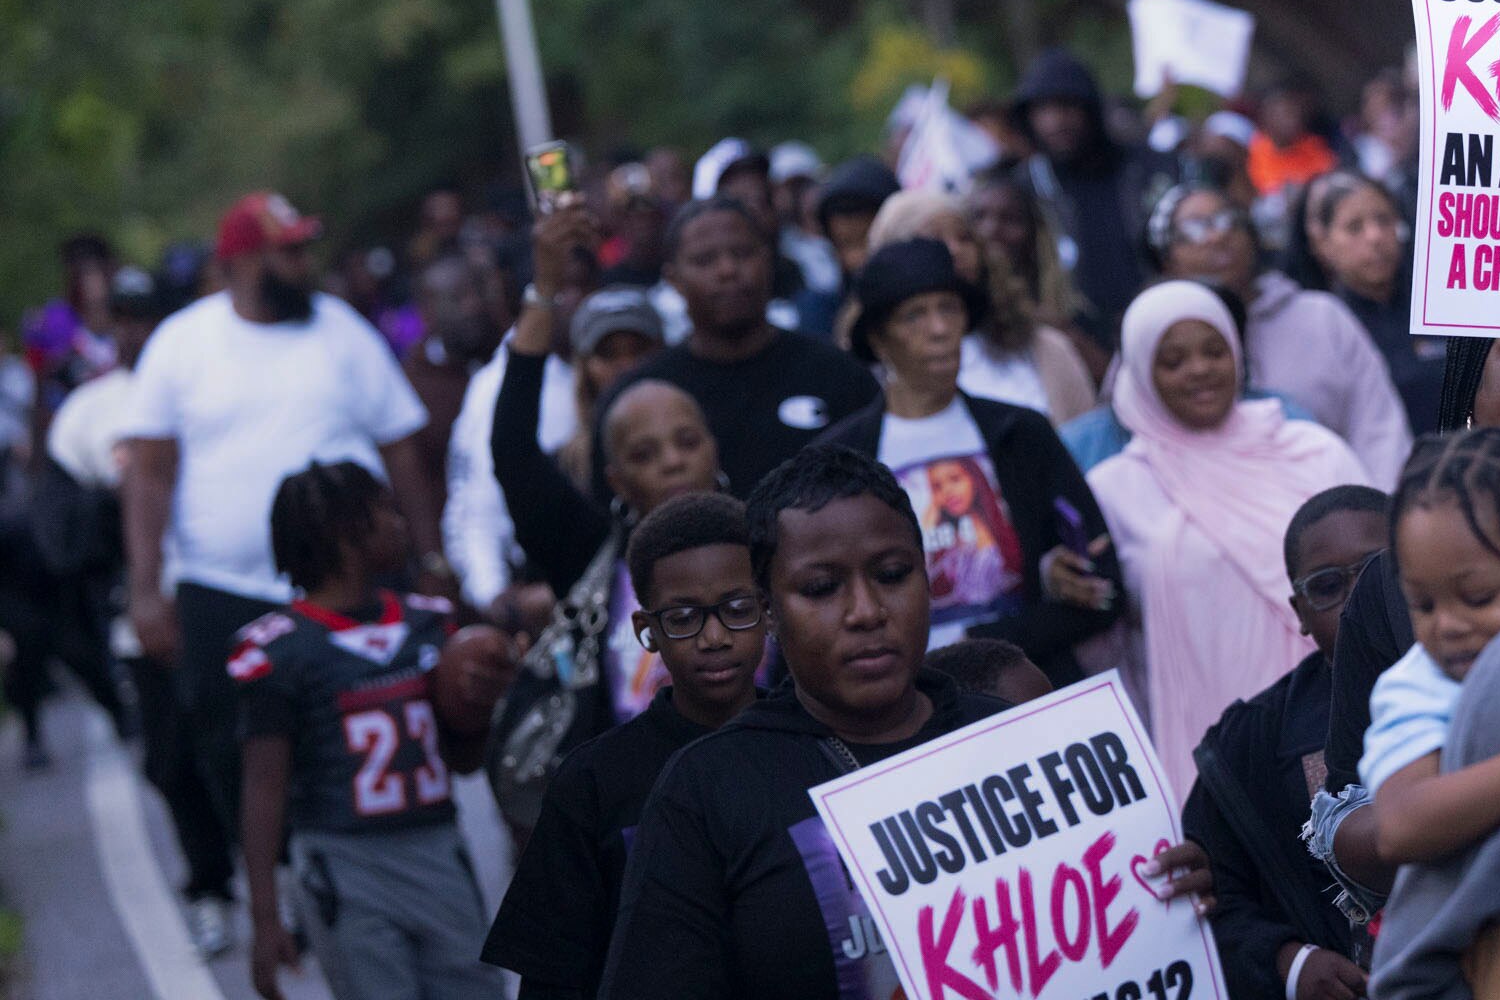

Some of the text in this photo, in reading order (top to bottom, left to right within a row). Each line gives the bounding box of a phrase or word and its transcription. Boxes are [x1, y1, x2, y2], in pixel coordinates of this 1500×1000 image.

[1440, 132, 1494, 188] AN
[1446, 243, 1467, 290] A
[869, 731, 1148, 896] JUSTICE FOR
[918, 830, 1139, 1000] KHLOE
